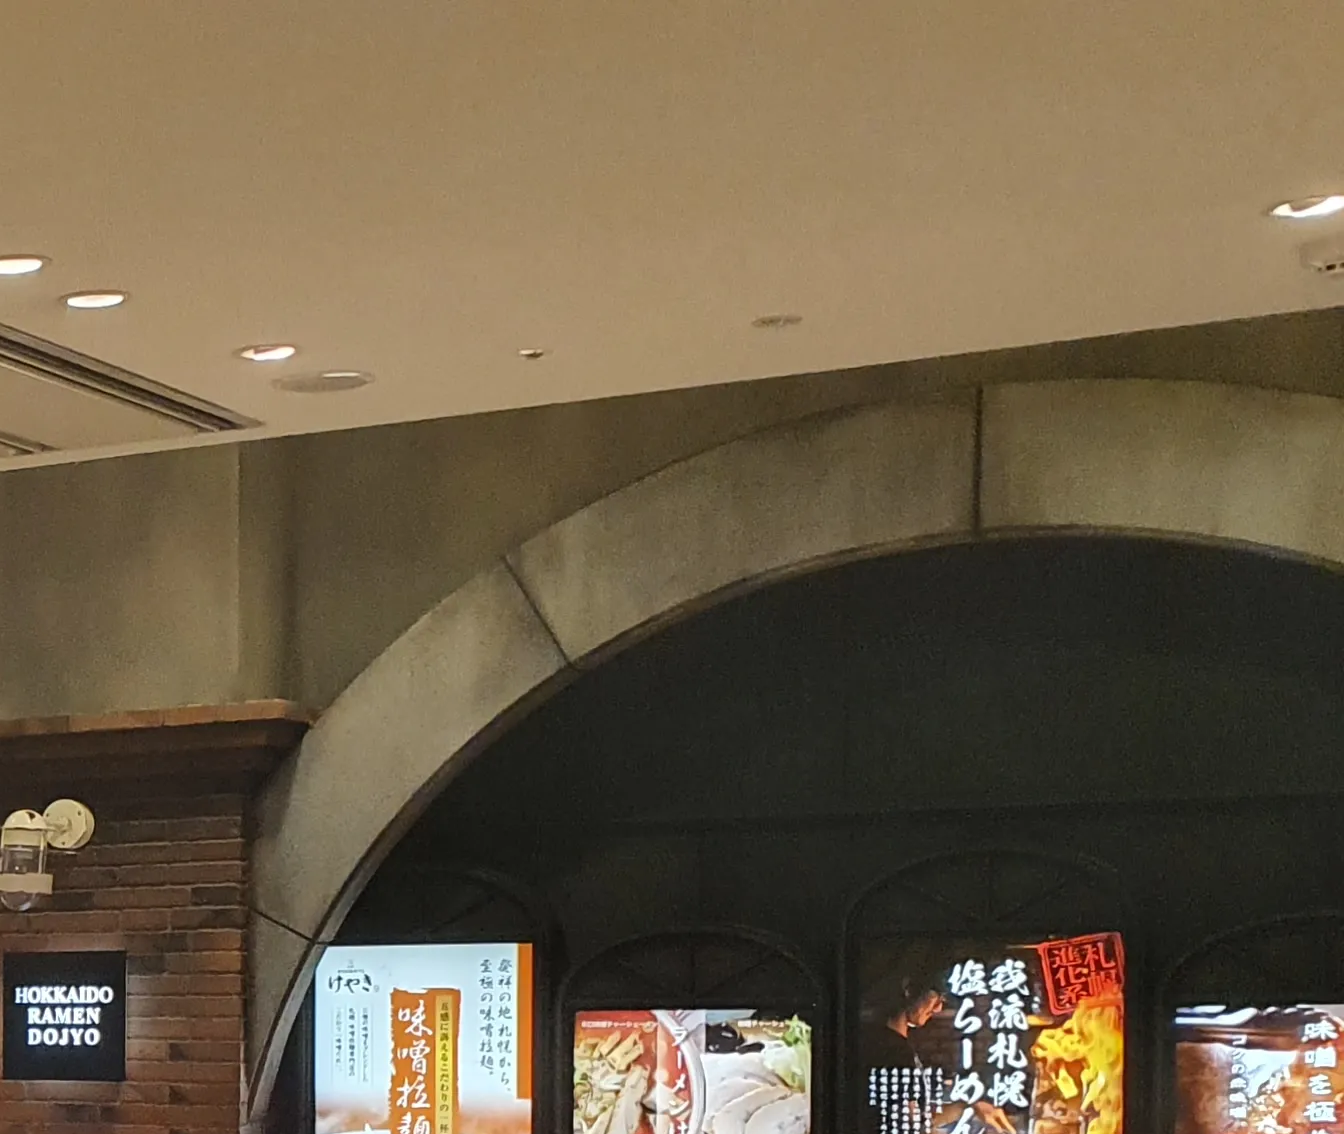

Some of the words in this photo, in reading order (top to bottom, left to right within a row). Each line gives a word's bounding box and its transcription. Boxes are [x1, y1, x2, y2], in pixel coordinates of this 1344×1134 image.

[328, 974, 372, 993] けやき
[15, 986, 114, 1004] HOKKAIDO
[27, 1007, 101, 1025] RAMEN
[27, 1028, 100, 1046] DOJYO
[987, 959, 1029, 1109] 我流札幌
